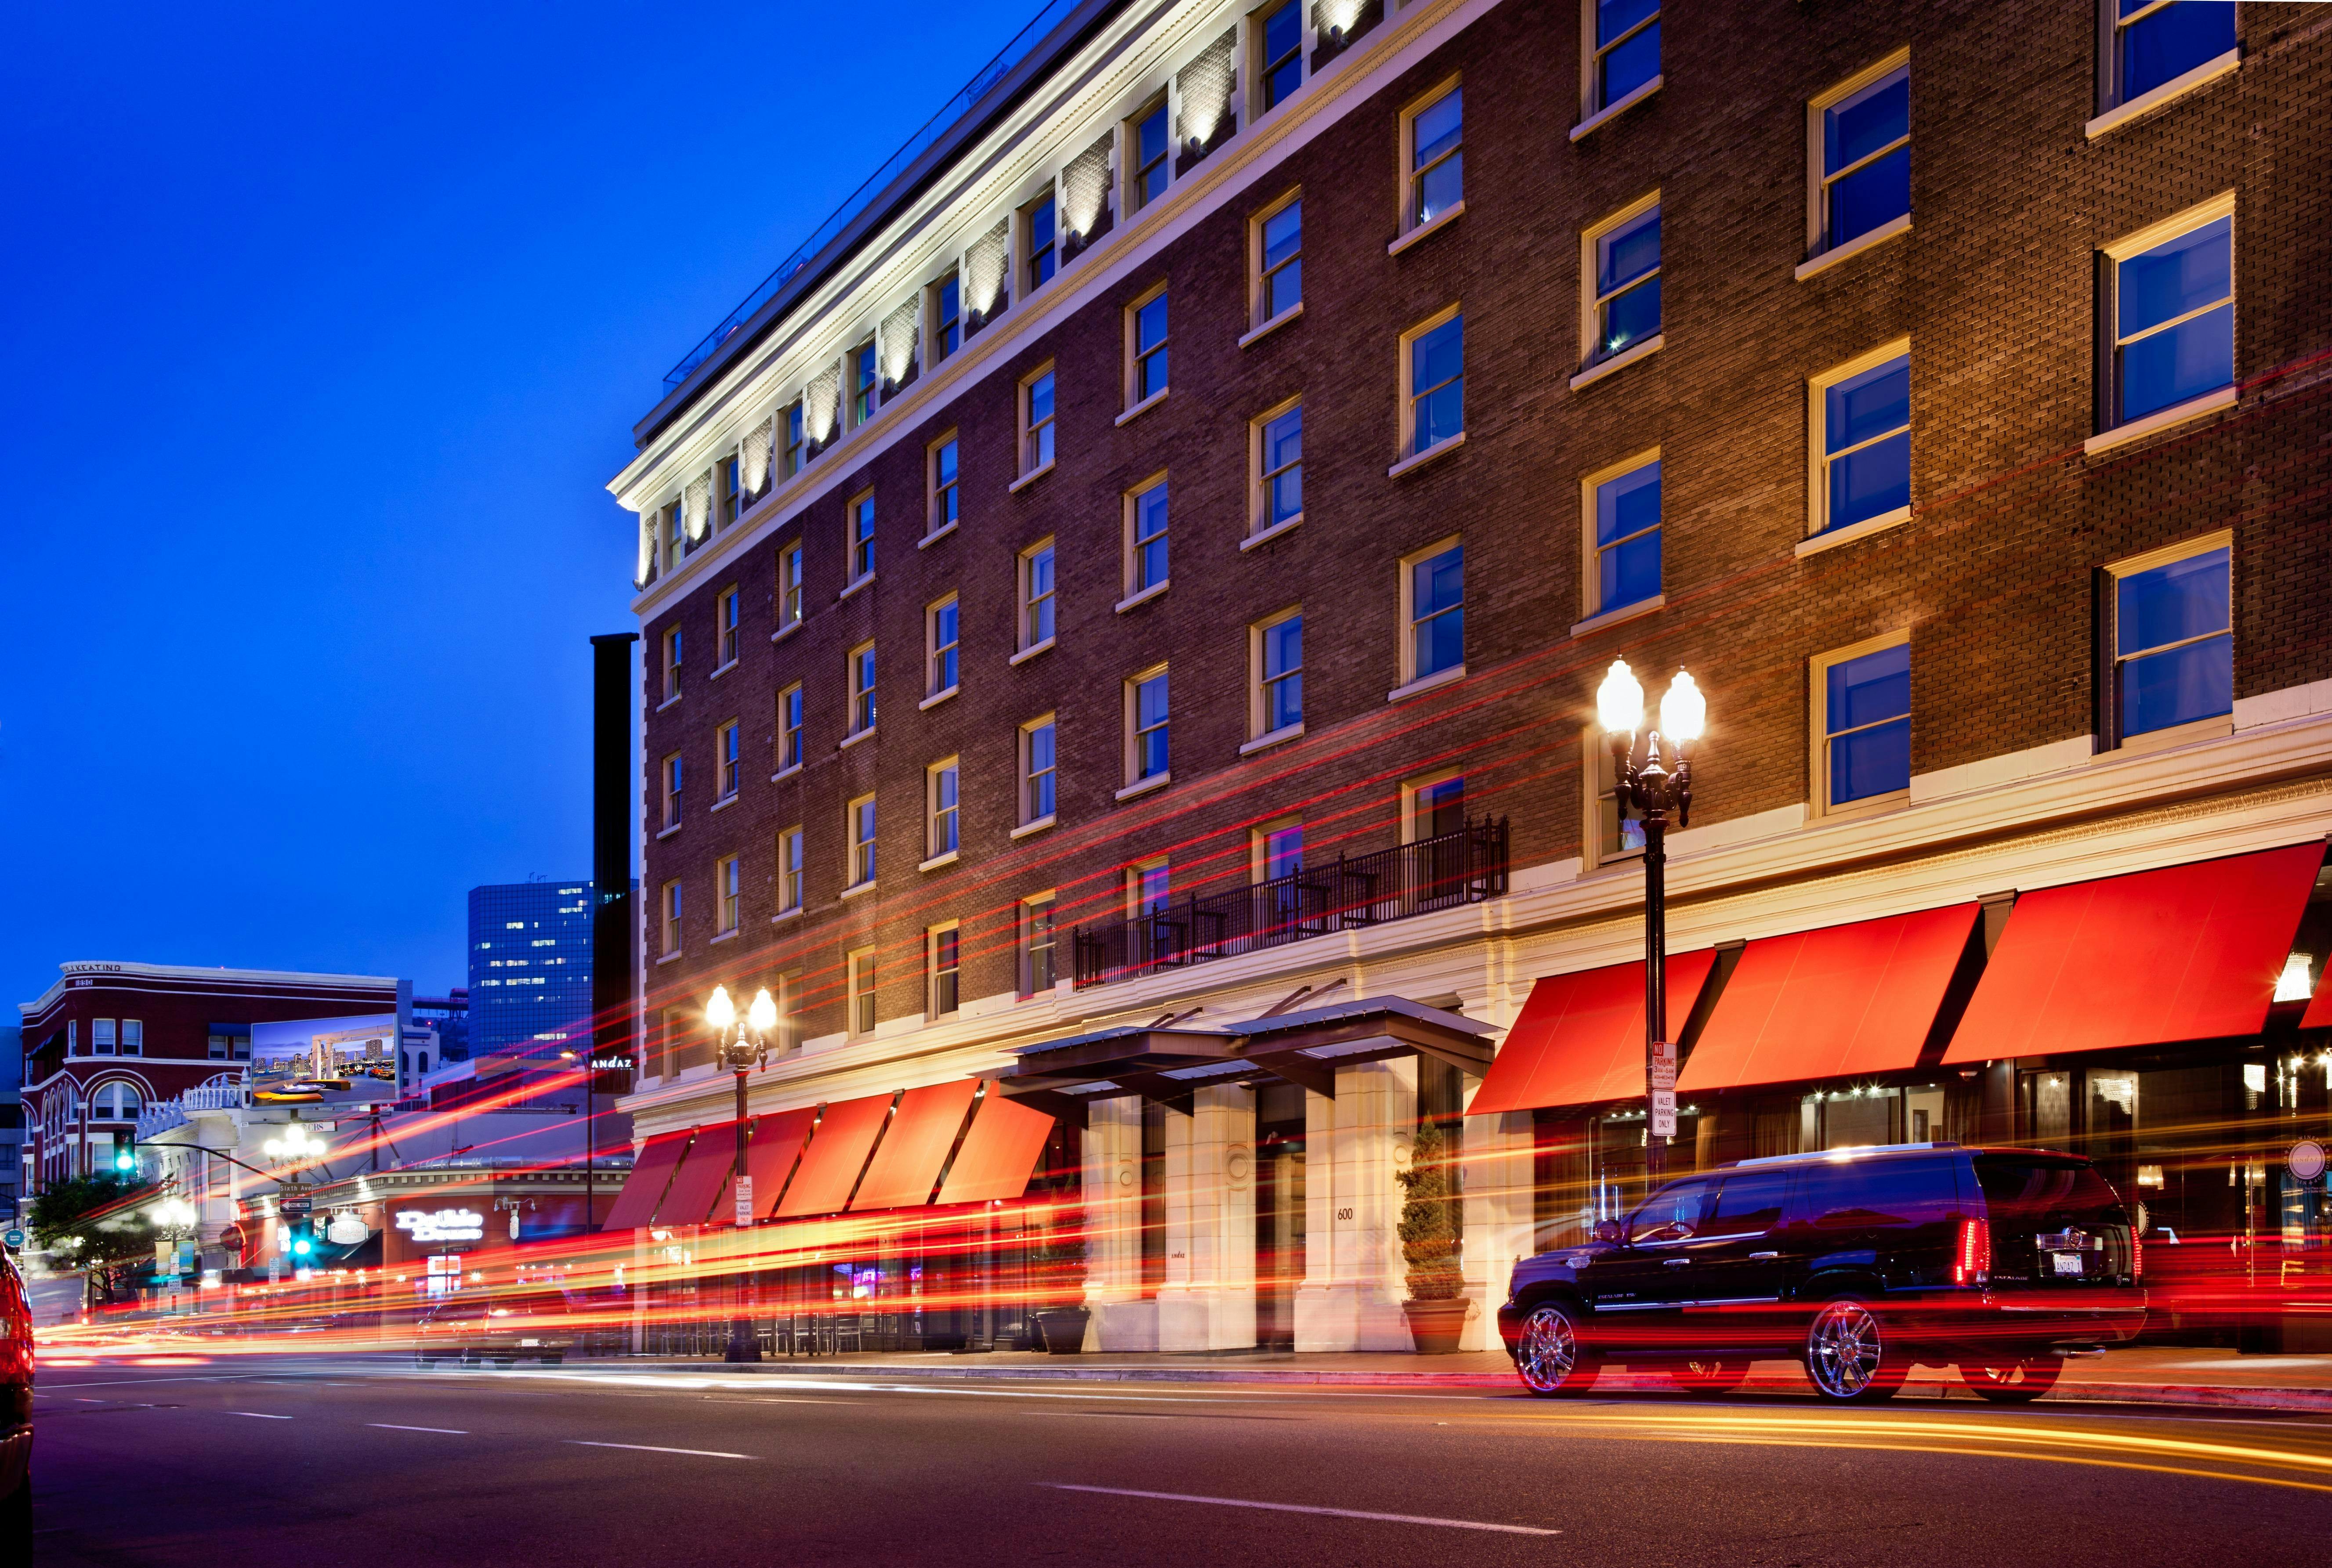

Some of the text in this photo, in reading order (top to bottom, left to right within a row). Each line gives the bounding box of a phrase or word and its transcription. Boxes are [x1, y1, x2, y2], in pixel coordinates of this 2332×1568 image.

[1655, 1044, 1662, 1055] NO
[1655, 1057, 1674, 1066] PARKING
[1658, 1097, 1670, 1106] VALET
[308, 1123, 324, 1131] CBS
[2298, 1135, 2326, 1148] WINEBAR
[2283, 1156, 2307, 1185] NIGHTCLUB
[2314, 1156, 2331, 1183] ROOFTOP
[1338, 1208, 1353, 1220] 600
[2057, 1262, 2081, 1272] ANDAZ 1
